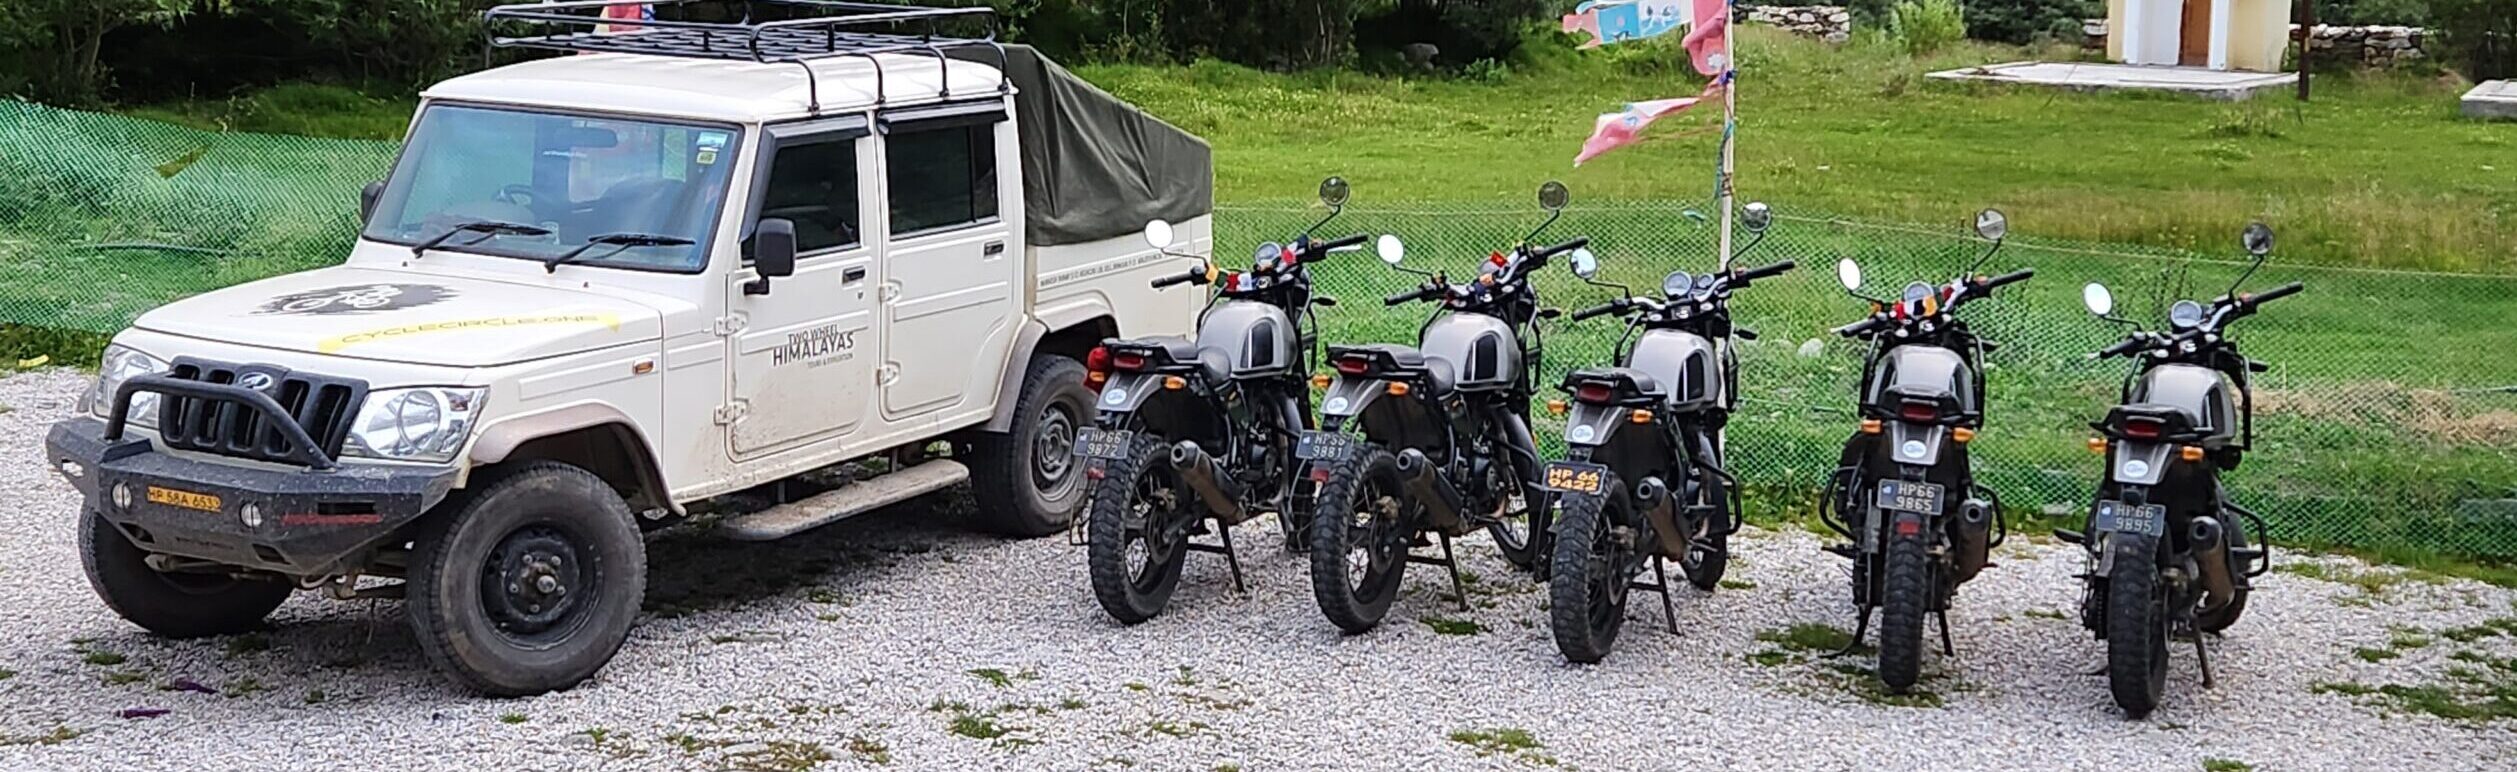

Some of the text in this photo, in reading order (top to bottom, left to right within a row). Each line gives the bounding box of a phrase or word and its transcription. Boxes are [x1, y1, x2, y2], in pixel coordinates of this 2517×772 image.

[788, 324, 838, 345] TWO WHEEL
[773, 331, 854, 367] HIMALAYAS
[1087, 442, 1119, 457] 9872
[1312, 445, 1343, 458] 9881
[1550, 468, 1600, 482] HP 66
[1548, 479, 1598, 491] 9422
[1898, 483, 1935, 498] HP66
[1896, 496, 1933, 511] 9865
[2116, 504, 2155, 519] HP66
[2116, 517, 2153, 532] 9895
